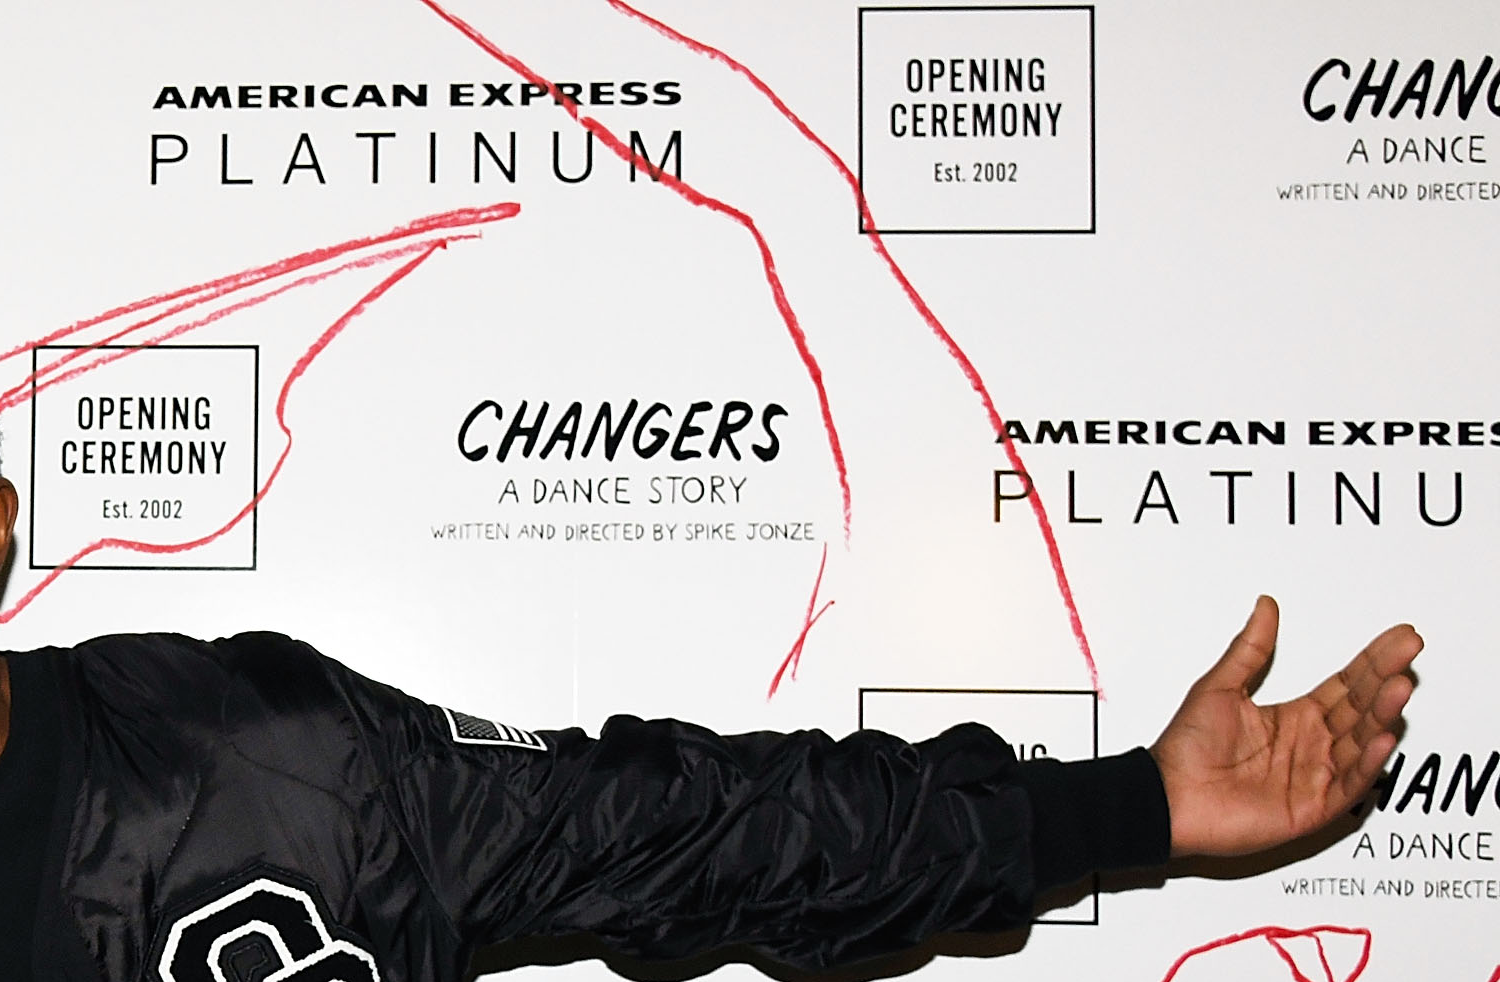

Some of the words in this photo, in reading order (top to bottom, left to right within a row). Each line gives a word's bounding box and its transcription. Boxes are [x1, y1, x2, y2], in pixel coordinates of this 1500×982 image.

[907, 58, 1044, 93] OPENING
[153, 84, 427, 109] AMERICAN
[450, 82, 681, 106] EXPRESS
[891, 103, 1061, 137] CEREMONY
[151, 130, 681, 185] PLATINUM
[1347, 139, 1368, 163] A
[1384, 136, 1486, 163] DANCE
[934, 162, 966, 182] Est.
[973, 162, 1017, 182] 2002
[1277, 182, 1359, 200] WRITTEN
[1367, 183, 1407, 200] AND
[78, 397, 210, 430] OPENING
[458, 399, 788, 463] CHANGERS
[995, 421, 1285, 445] AMERICAN
[62, 441, 226, 474] CEREMONY
[499, 480, 518, 503] A
[534, 478, 630, 504] DANCE
[649, 476, 746, 503] STORY
[995, 470, 1462, 526] PLATINU
[103, 499, 133, 519] Est.
[140, 499, 182, 519] 2002
[431, 523, 509, 540] WRITTEN
[518, 524, 555, 540] AND
[566, 523, 644, 541] DIRECTED
[653, 524, 677, 541] BY
[686, 523, 736, 541] SPIKE
[747, 523, 814, 541] JONZE
[1353, 833, 1374, 858] A
[1390, 832, 1493, 860] DANCE
[1282, 878, 1364, 896] WRITTEN
[1373, 880, 1414, 897] AND
[1424, 879, 1500, 899] DIRECTE
